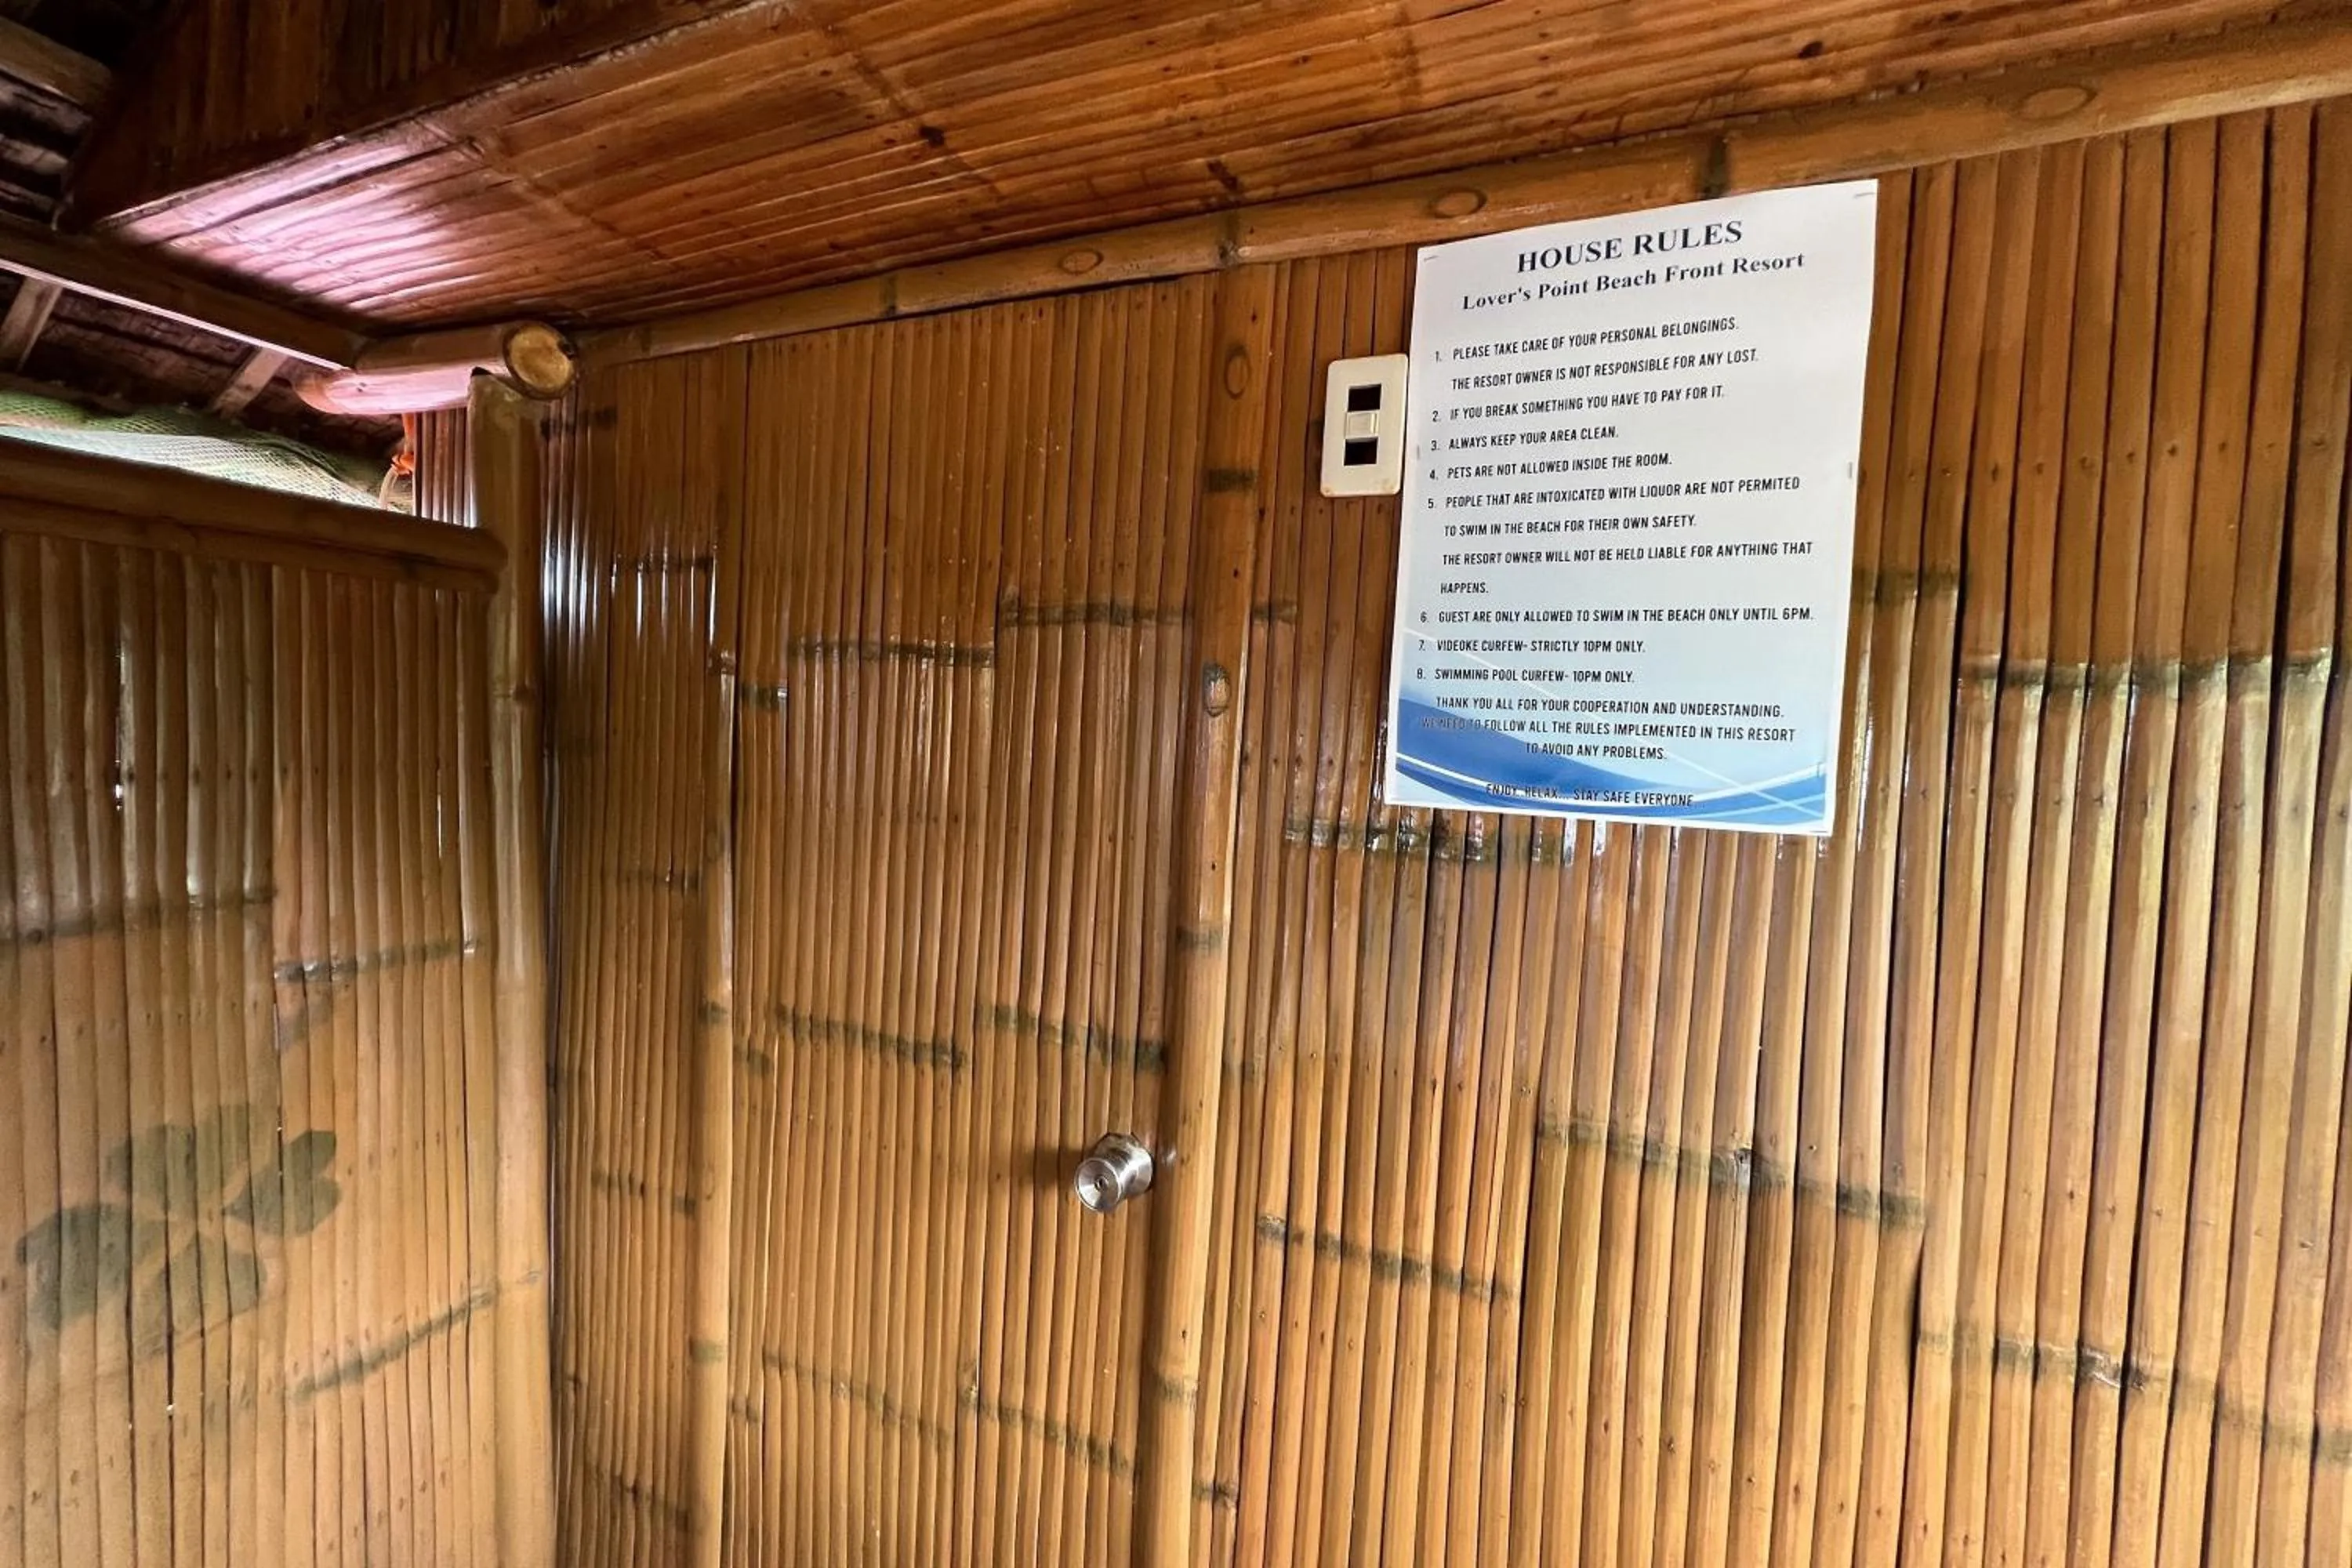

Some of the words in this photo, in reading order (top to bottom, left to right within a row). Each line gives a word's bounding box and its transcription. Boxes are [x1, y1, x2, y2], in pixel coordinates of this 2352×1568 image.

[1517, 238, 1624, 274] HOUSE
[1632, 220, 1743, 257] RULES
[1462, 285, 1531, 310] Lover's
[1537, 278, 1591, 300] Point
[1595, 269, 1657, 292] Beach
[1664, 260, 1726, 284] Front
[1732, 252, 1806, 275] Resort
[1452, 344, 1491, 361] PLEASE
[1492, 340, 1519, 356] TAKE
[1521, 337, 1549, 354] CARE
[1551, 335, 1566, 350] OF
[1568, 332, 1598, 350] YOUR
[1599, 325, 1659, 345] PERSONAL
[1661, 316, 1740, 339] BELONGINGS.
[1450, 376, 1472, 391] THE
[1472, 372, 1514, 389] RESORT
[1515, 368, 1554, 386] OWNER
[1555, 367, 1567, 382] IS
[1568, 364, 1592, 380] NOT
[1593, 356, 1671, 377] RESPONSIBLE
[1671, 354, 1697, 370] FOR
[1697, 350, 1726, 368] ANY
[1726, 347, 1759, 365] LOST.
[1450, 407, 1461, 421] IF
[1462, 405, 1483, 420] YOU
[1484, 402, 1519, 419] BREAK
[1521, 397, 1584, 415] SOMETHING
[1586, 394, 1609, 410] YOU
[1610, 390, 1642, 408] HAVE
[1642, 389, 1659, 405] TO
[1660, 388, 1683, 402] PAY
[1685, 386, 1709, 401] FOR
[1711, 384, 1725, 399] IT.
[1430, 439, 1441, 452] 3.
[1448, 434, 1488, 451] ALWAYS
[1490, 433, 1517, 448] KEEP
[1519, 430, 1548, 446] YOUR
[1548, 428, 1577, 443] AREA
[1580, 425, 1619, 441] CLEAN.
[1428, 468, 1439, 481] 4.
[1446, 466, 1472, 480] PETS
[1473, 464, 1495, 477] ARE
[1496, 463, 1518, 477] NOT
[1518, 459, 1570, 475] ALLOWED
[1571, 456, 1609, 471] INSIDE
[1610, 455, 1633, 471] THE
[1634, 452, 1673, 468] ROOM.
[1445, 494, 1484, 510] PEOPLE
[1486, 492, 1512, 507] THAT
[1512, 491, 1534, 506] ARE
[1535, 488, 1606, 504] INTOXICATED
[1607, 485, 1637, 499] WITH
[1639, 483, 1682, 499] LIQUOR
[1683, 481, 1708, 496] ARE
[1710, 479, 1735, 495] NOT
[1737, 476, 1801, 493] PERMITED
[1443, 524, 1459, 537] TO
[1458, 523, 1488, 538] SWIM
[1490, 522, 1501, 536] IN
[1504, 521, 1526, 535] THE
[1526, 520, 1562, 535] BEACH
[1563, 519, 1585, 533] FOR
[1588, 517, 1621, 532] THEIR
[1621, 516, 1650, 530] OWN
[1651, 514, 1697, 529] SAFETY.
[1443, 553, 1462, 566] THE
[1463, 551, 1504, 565] RESORT
[1504, 550, 1543, 564] OWNER
[1544, 550, 1573, 563] WILL
[1573, 547, 1598, 562] NOT
[1598, 547, 1614, 561] BE
[1615, 546, 1645, 561] HELD
[1646, 545, 1688, 560] LIABLE
[1690, 544, 1714, 558] FOR
[1715, 542, 1779, 558] ANYTHING
[1782, 541, 1813, 556] THAT
[1439, 581, 1490, 595] HAPPENS.
[1438, 610, 1471, 624] GUEST
[1471, 608, 1493, 623] ARE
[1494, 610, 1522, 625] ONLY
[1523, 609, 1573, 622] ALLOWED
[1576, 608, 1591, 622] TO
[1592, 608, 1624, 623] SWIM
[1626, 608, 1640, 622] IN
[1642, 608, 1664, 622] THE
[1667, 608, 1706, 622] BEACH
[1708, 608, 1740, 622] ONLY
[1742, 607, 1779, 622] UNTIL
[1781, 606, 1814, 621] 6PM.
[1436, 639, 1479, 653] VIDEOKE
[1480, 639, 1529, 652] CURFEW-
[1530, 639, 1581, 653] STRICTLY
[1582, 639, 1613, 653] 10PM
[1615, 640, 1646, 653] ONLY.
[1416, 667, 1427, 681] 8.
[1434, 667, 1490, 682] SWIMMING
[1491, 668, 1519, 683] POOL
[1519, 669, 1570, 683] CURFEW-
[1572, 670, 1602, 684] 10PM
[1604, 670, 1635, 684] ONLY.
[1436, 695, 1470, 710] THANK
[1472, 696, 1494, 710] YOU
[1494, 697, 1514, 711] ALL
[1517, 698, 1539, 712] FOR
[1539, 698, 1570, 713] YOUR
[1572, 699, 1650, 715] COOPERATION
[1651, 702, 1678, 716] AND
[1679, 702, 1784, 718] UNDERSTANDING.
[1422, 717, 1436, 728] WE
[1439, 717, 1466, 730] NEED
[1468, 718, 1481, 730] TO
[1484, 719, 1526, 732] FOLLOW
[1528, 719, 1549, 734] ALL
[1550, 720, 1573, 735] THE
[1574, 719, 1610, 736] RULES
[1613, 720, 1697, 739] IMPLEMENTED
[1699, 724, 1713, 739] IN
[1716, 726, 1745, 741] THIS
[1747, 727, 1796, 742] RESORT
[1526, 742, 1539, 754] TO
[1541, 742, 1573, 757] AVOID
[1576, 743, 1599, 757] ANY
[1602, 744, 1668, 760] PROBLEMS.
[1573, 789, 1599, 801] STAY
[1603, 790, 1630, 804] SAFE
